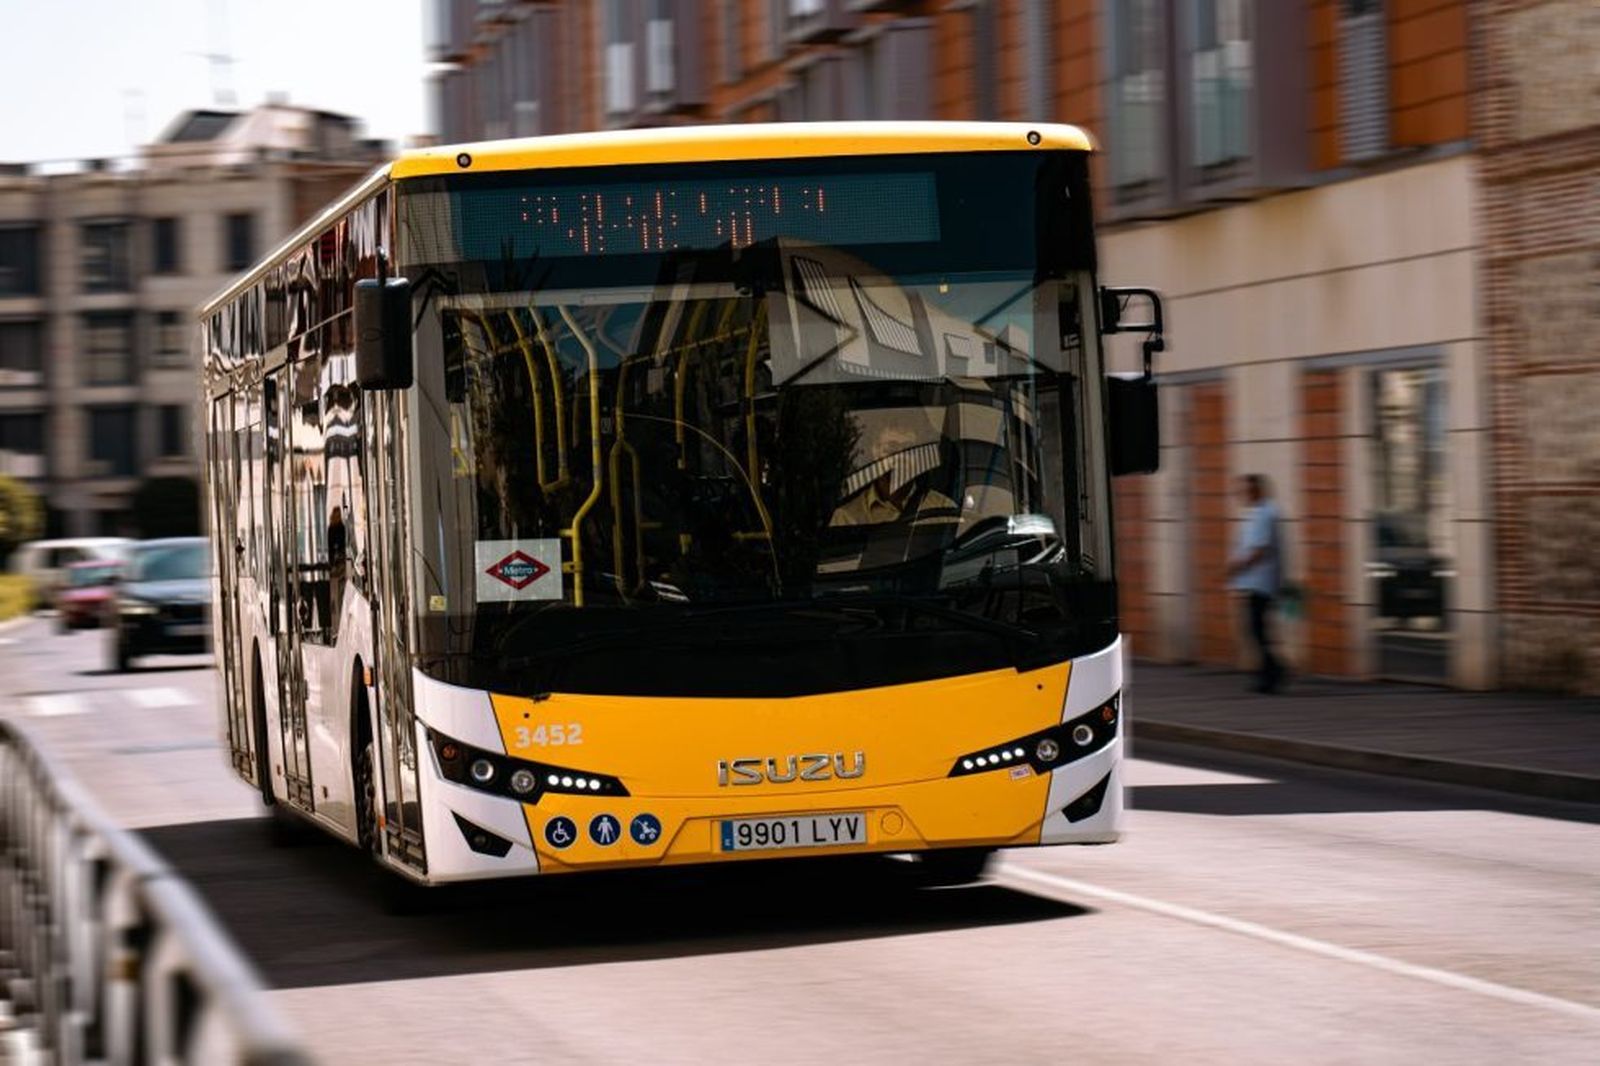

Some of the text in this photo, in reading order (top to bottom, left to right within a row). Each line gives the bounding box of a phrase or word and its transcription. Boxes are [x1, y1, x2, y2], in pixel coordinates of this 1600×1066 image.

[503, 565, 533, 576] Metro
[515, 723, 583, 748] 3452
[717, 751, 865, 787] ISUZU
[738, 816, 859, 846] 9901 LYV
